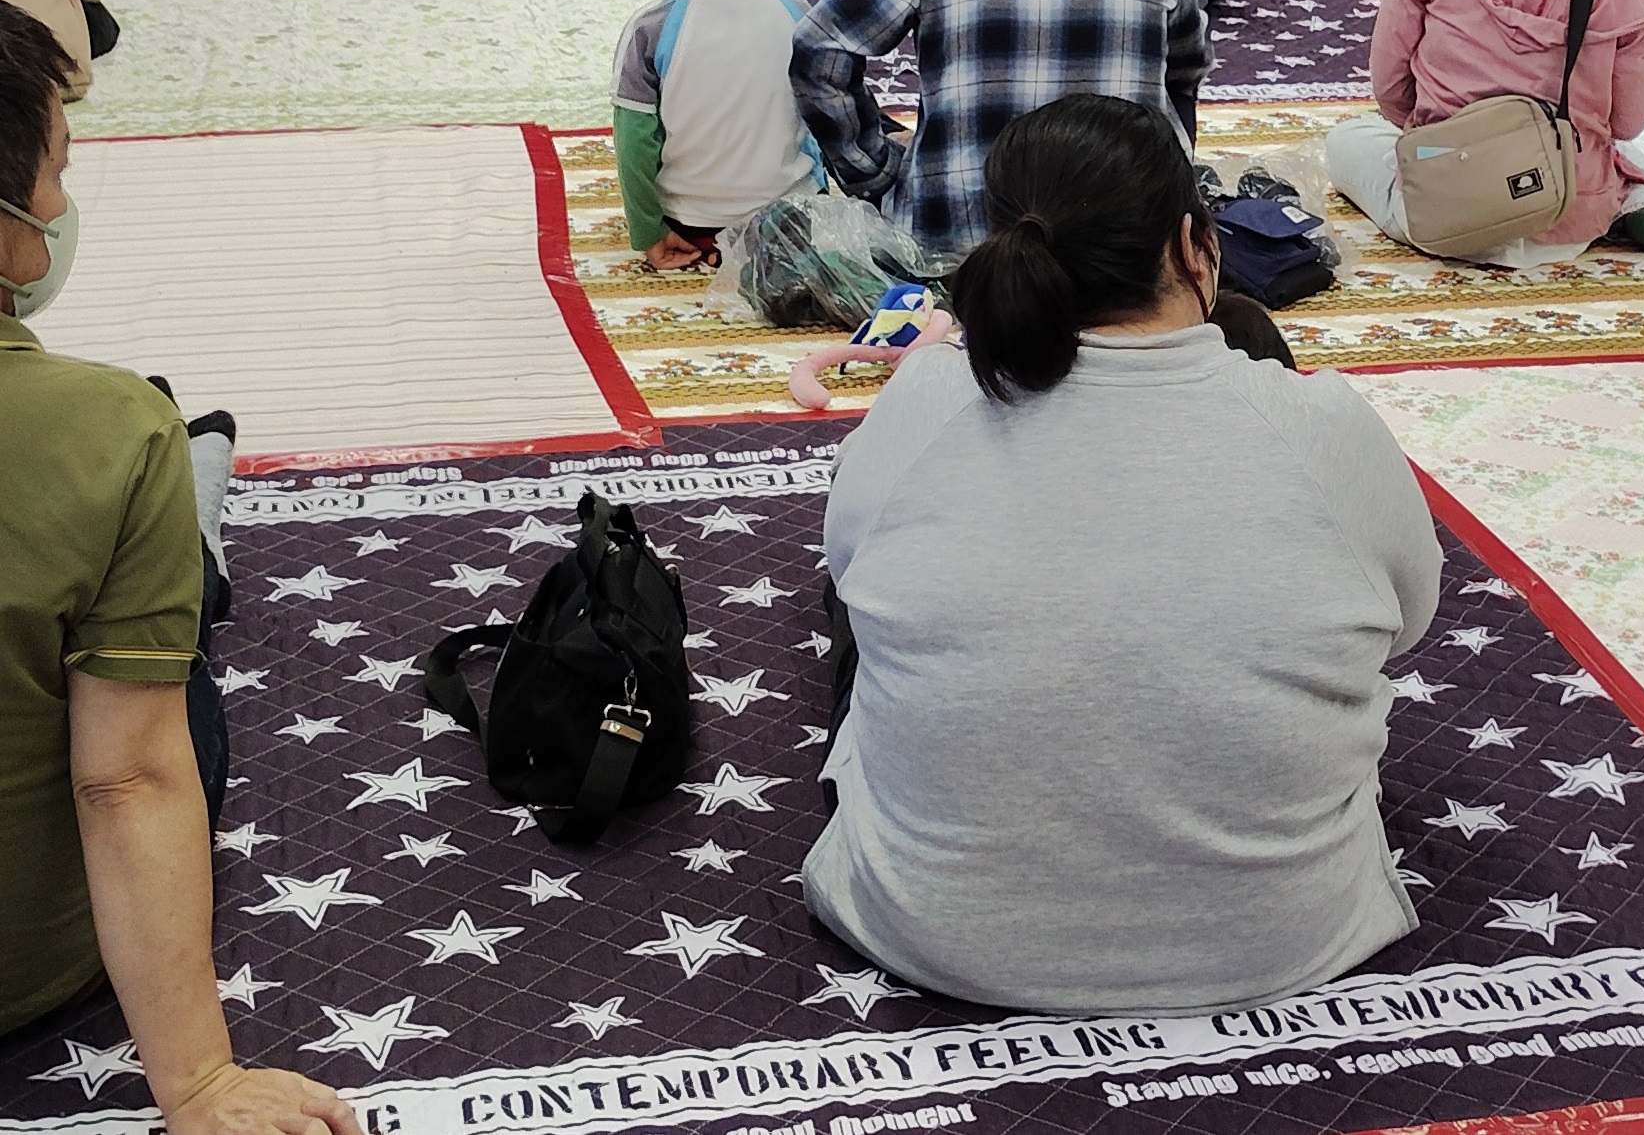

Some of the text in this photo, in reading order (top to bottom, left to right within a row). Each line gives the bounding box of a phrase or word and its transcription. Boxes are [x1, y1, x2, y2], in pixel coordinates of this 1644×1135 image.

[1211, 969, 1619, 1038] CONTEMPORARY
[461, 1045, 914, 1125] CONTEMPORARY
[933, 1022, 1168, 1072] FEELING
[1101, 1073, 1239, 1108] Staying
